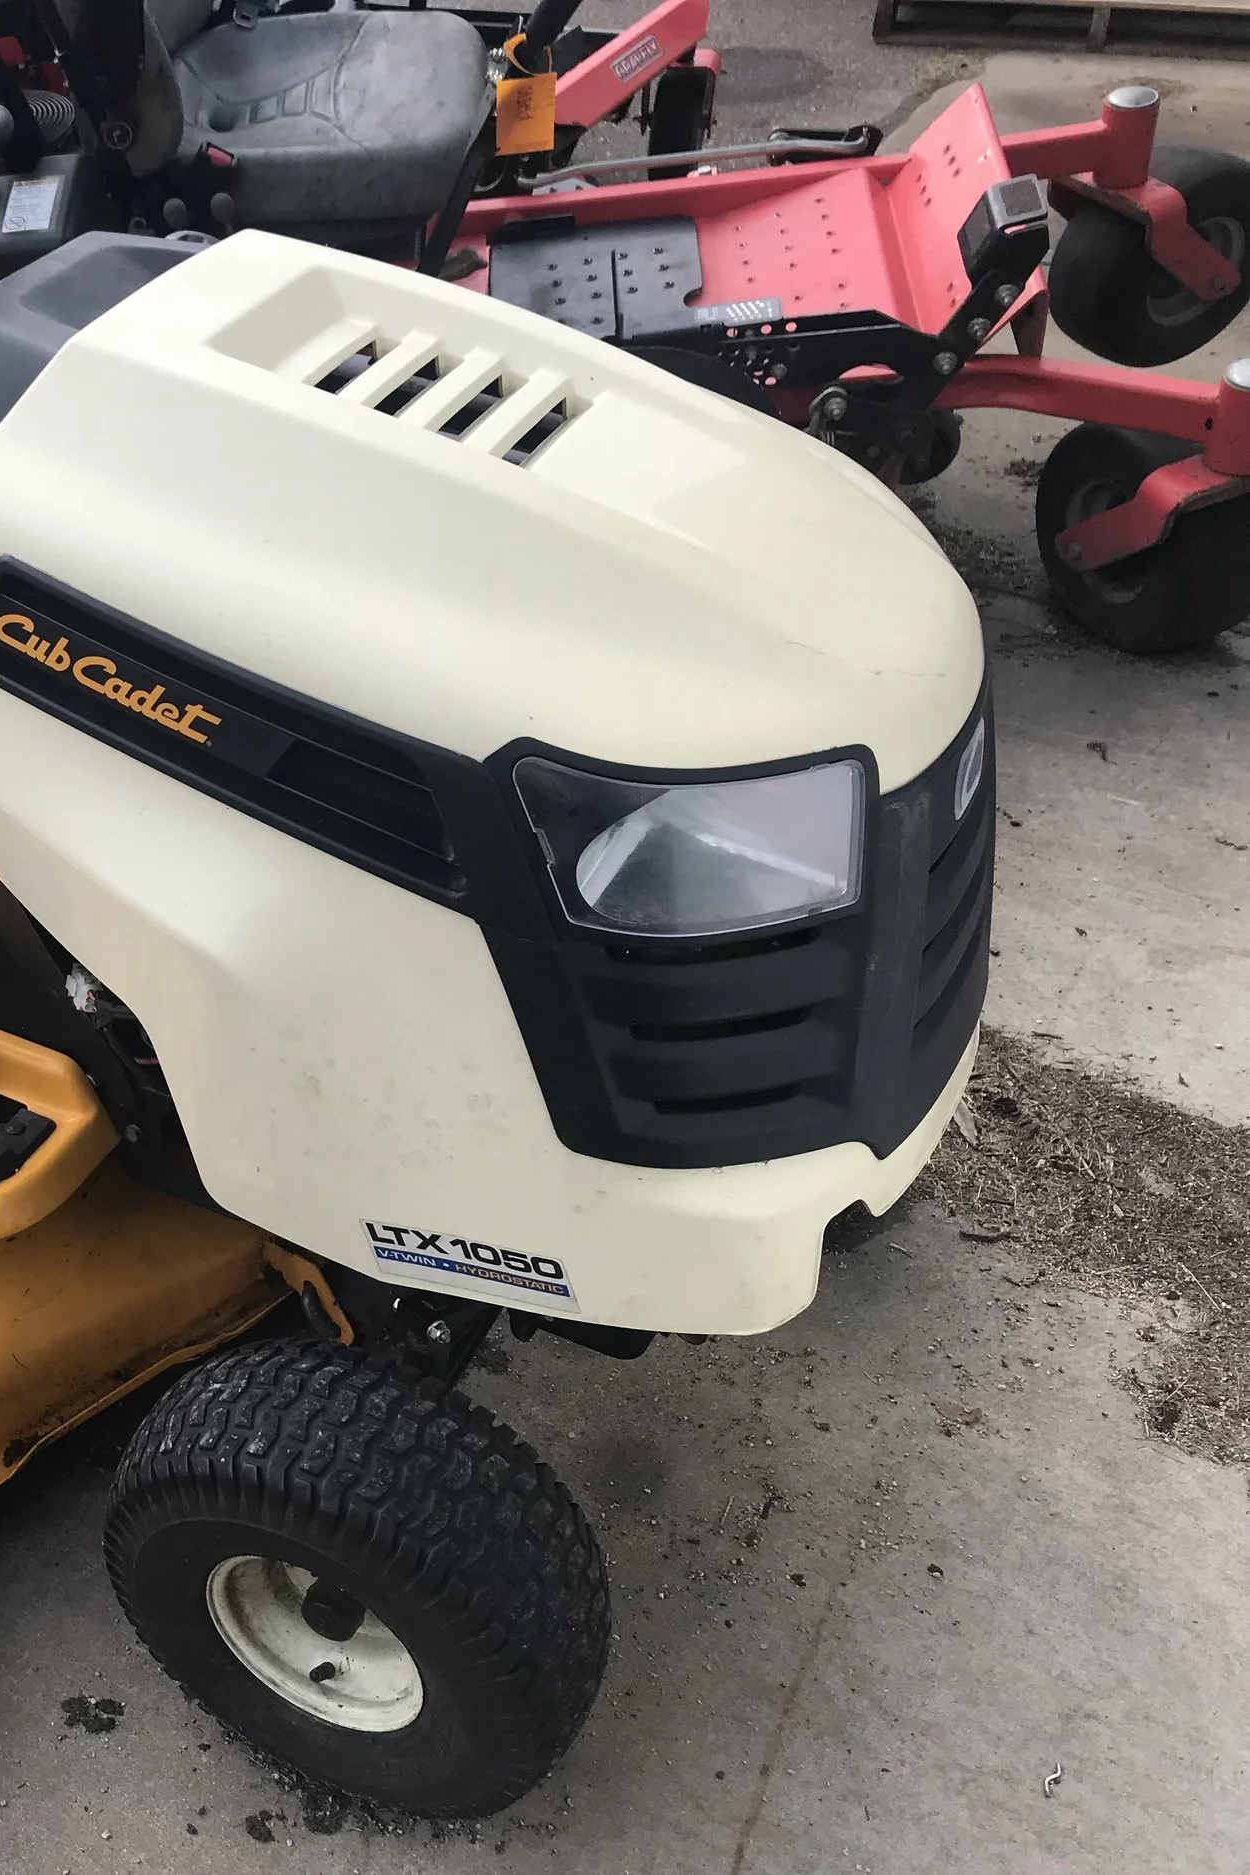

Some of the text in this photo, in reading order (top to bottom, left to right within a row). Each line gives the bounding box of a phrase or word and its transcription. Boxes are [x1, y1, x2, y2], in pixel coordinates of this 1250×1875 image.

[72, 654, 223, 745] Cadet
[365, 1222, 564, 1280] LTX 1050
[378, 1247, 565, 1295] V-TWIN HYDROSTATIC
